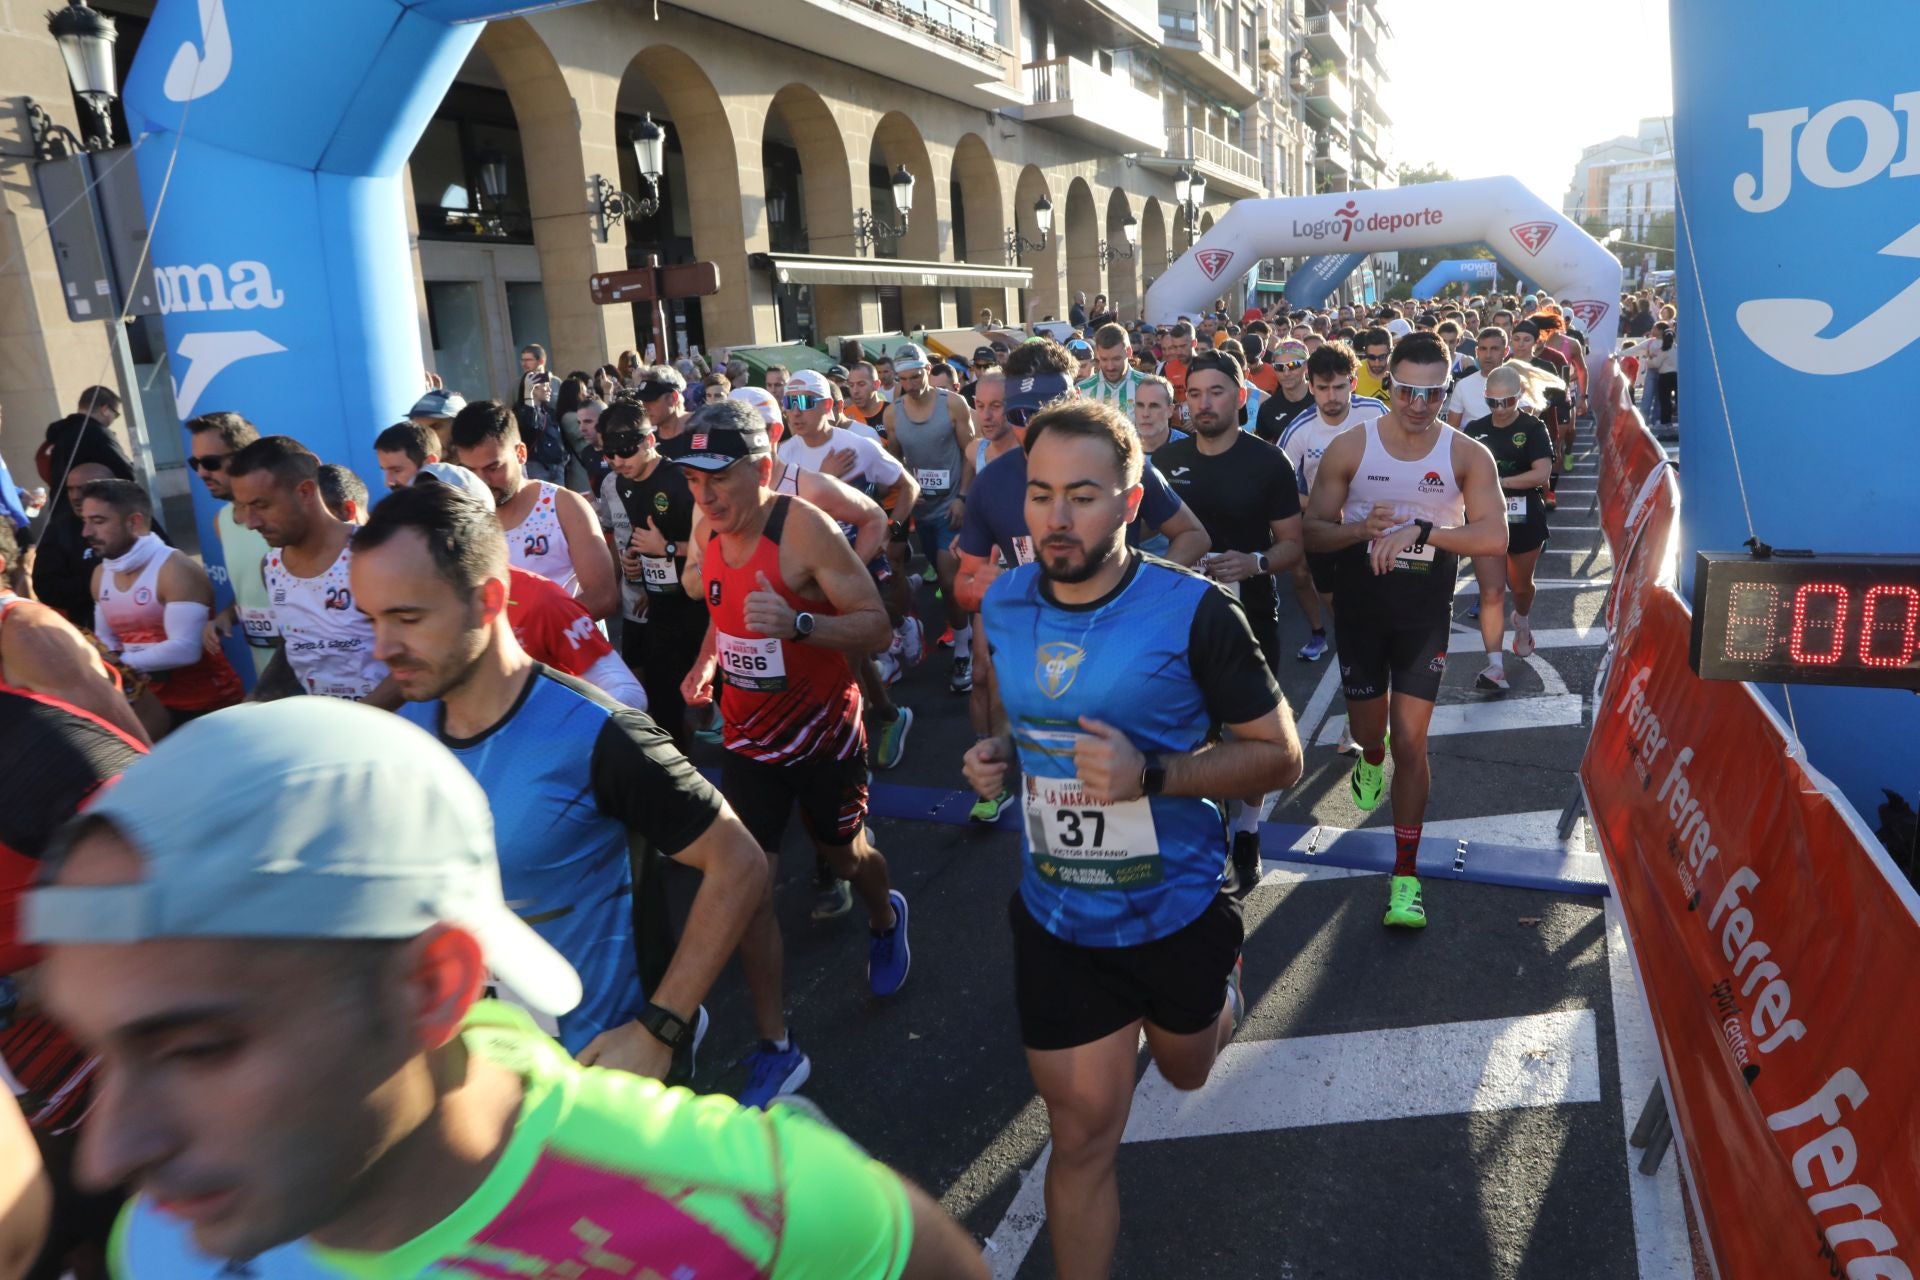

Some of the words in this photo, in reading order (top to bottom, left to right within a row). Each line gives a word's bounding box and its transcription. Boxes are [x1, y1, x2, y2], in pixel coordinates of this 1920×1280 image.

[1367, 208, 1443, 233] deporte
[153, 260, 284, 315] oma
[723, 650, 767, 671] 1266
[1616, 666, 1668, 766] ferrer
[1056, 809, 1105, 848] 37
[1657, 746, 1719, 879] ferrer
[1707, 866, 1807, 1054] ferrer
[1721, 1016, 1750, 1070] center
